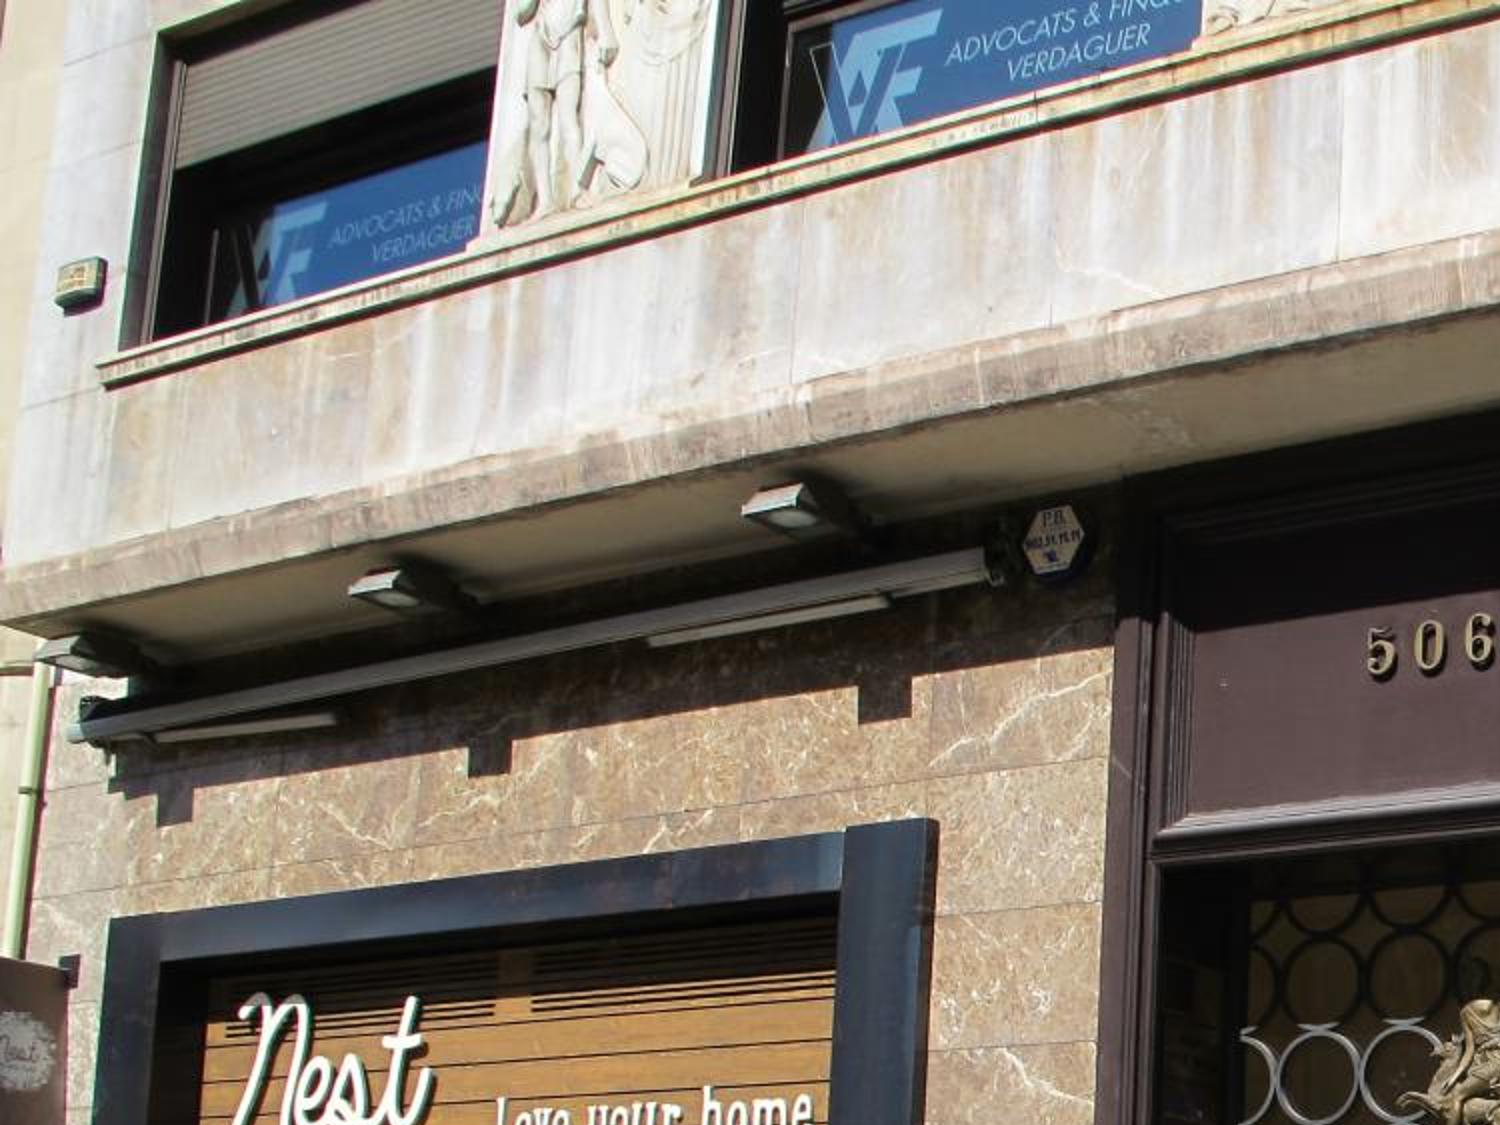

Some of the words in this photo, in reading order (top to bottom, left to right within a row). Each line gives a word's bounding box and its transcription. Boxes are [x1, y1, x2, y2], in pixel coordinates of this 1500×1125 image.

[944, 8, 1077, 66] ADVOCATS
[1083, 2, 1100, 27] &
[1007, 23, 1151, 81] VERDAGUER
[330, 200, 425, 249] ADVOCATS
[371, 214, 476, 262] VERDAGUER
[1367, 613, 1493, 675] 506
